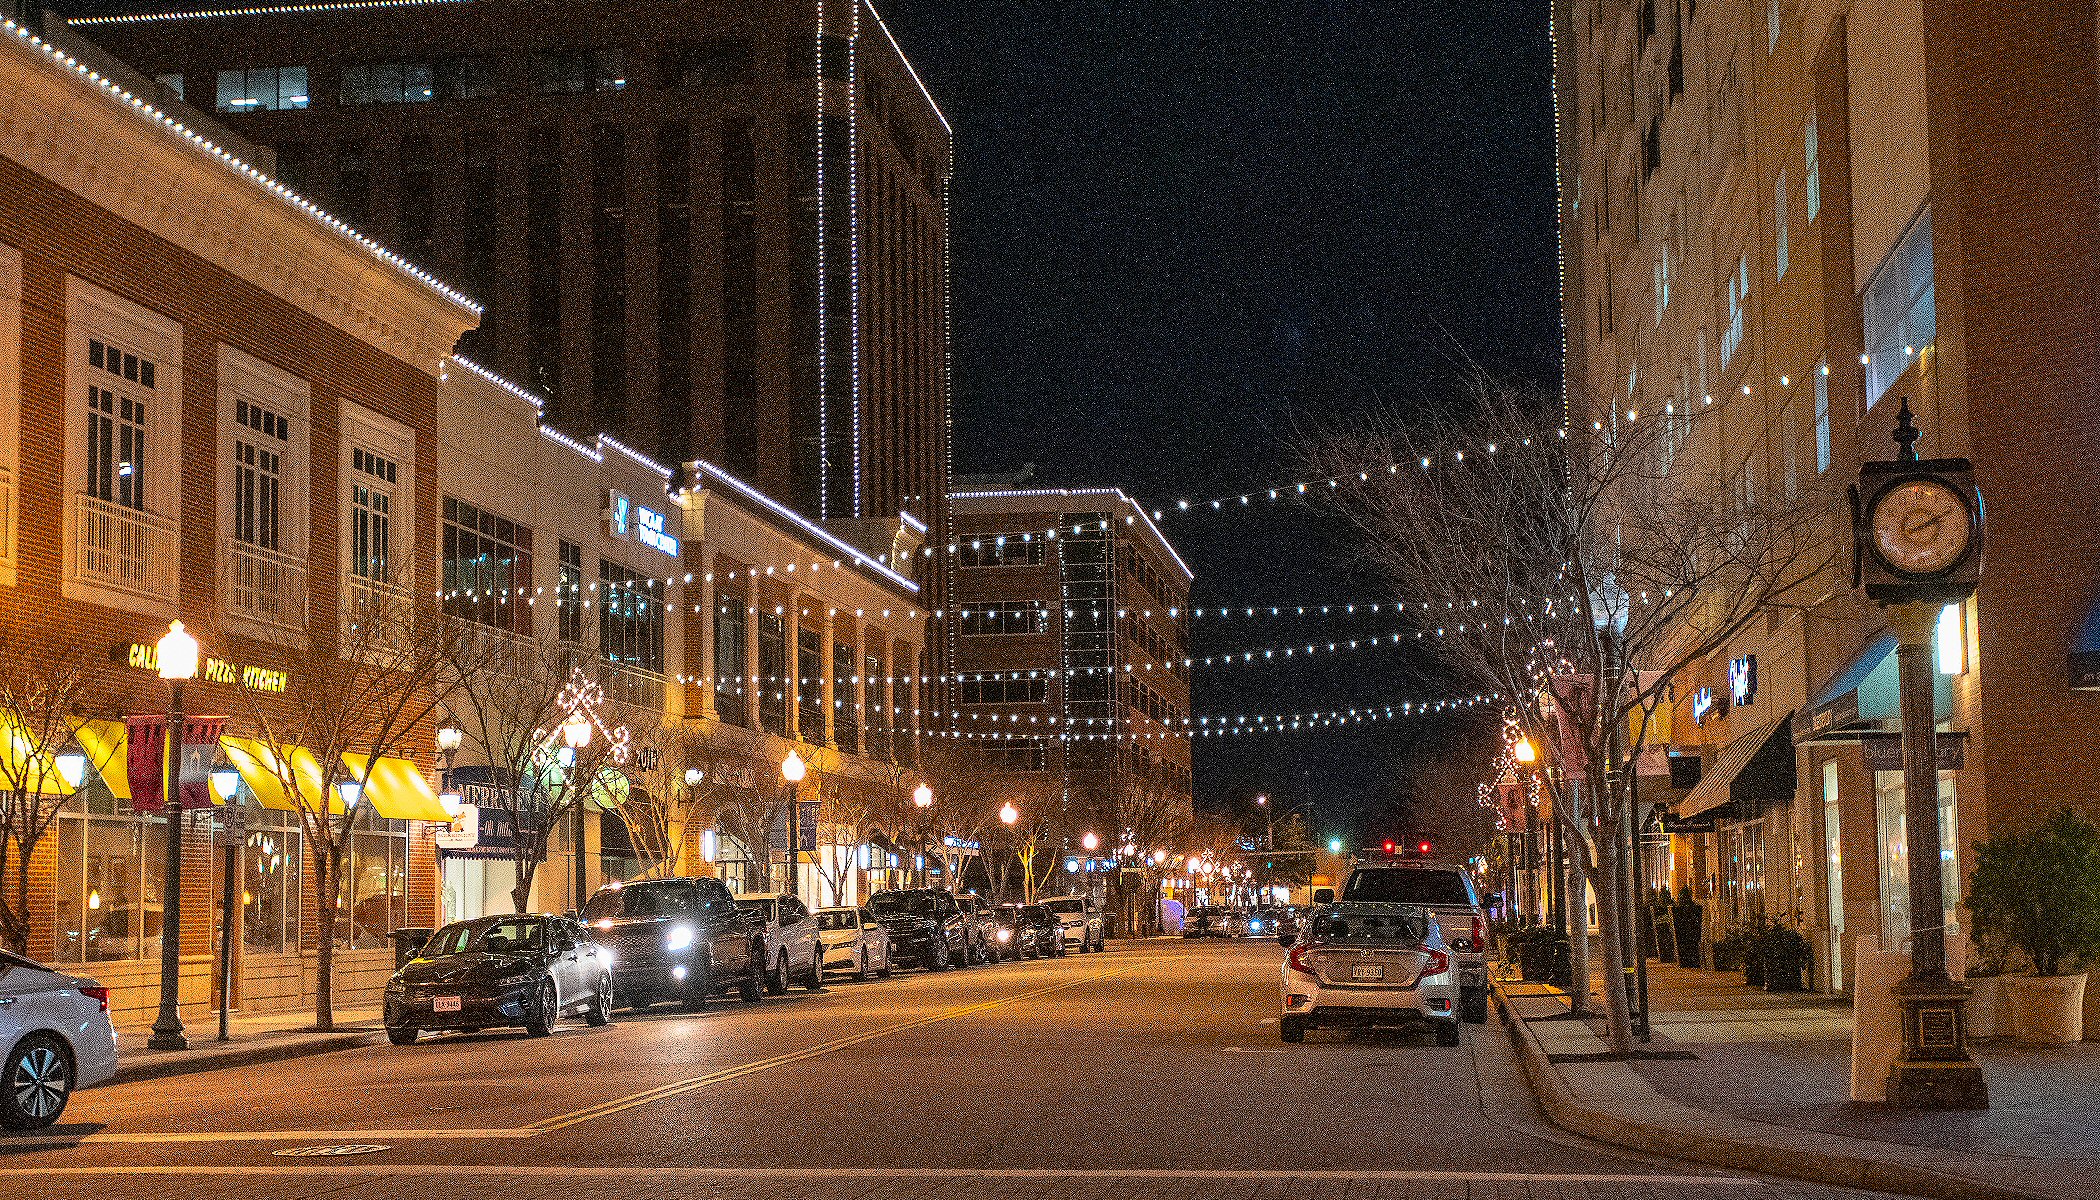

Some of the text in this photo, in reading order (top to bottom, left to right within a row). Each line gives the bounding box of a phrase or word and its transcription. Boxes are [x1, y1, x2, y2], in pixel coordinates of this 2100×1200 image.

[205, 658, 236, 684] PIZZA
[243, 665, 287, 693] KITCHEN
[1864, 743, 1961, 761] blueury
